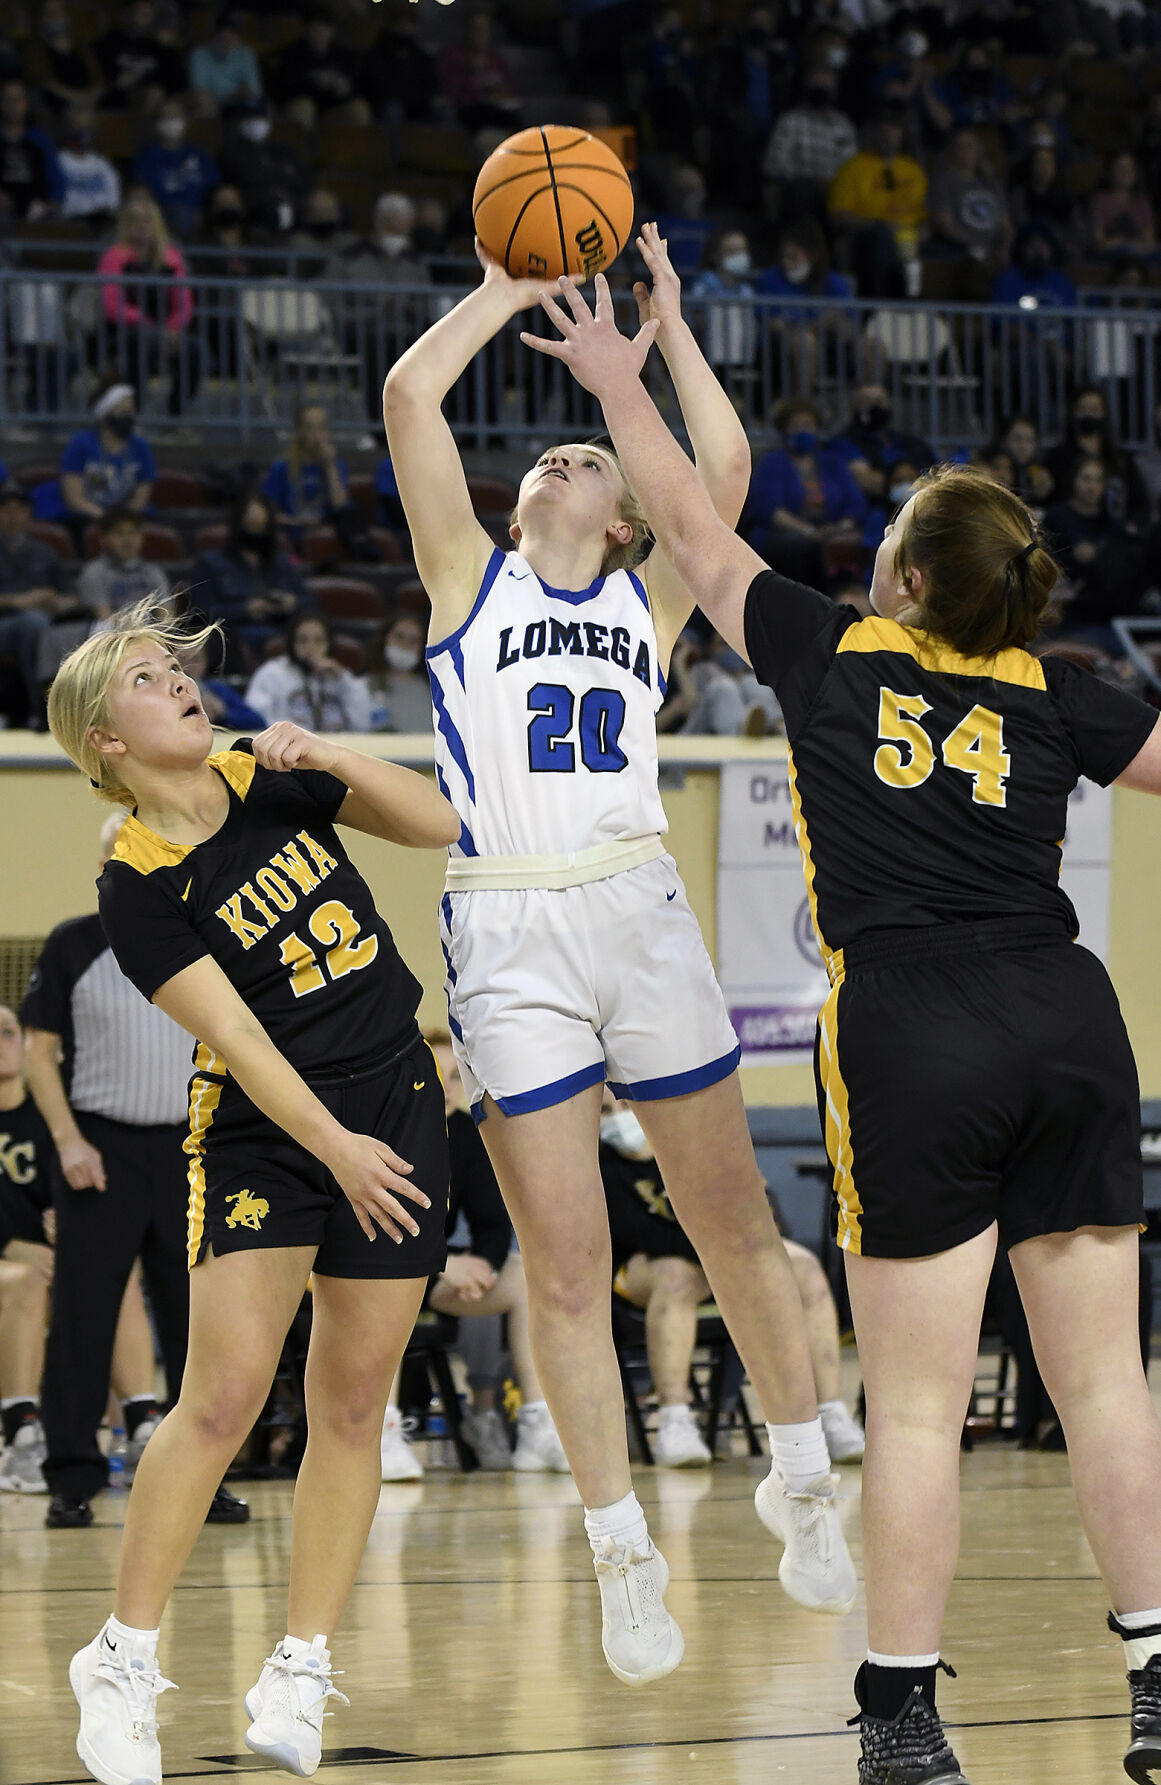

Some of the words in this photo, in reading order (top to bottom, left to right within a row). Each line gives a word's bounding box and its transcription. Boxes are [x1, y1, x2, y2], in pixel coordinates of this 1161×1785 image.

[575, 219, 607, 277] Wil
[496, 617, 651, 691] LOMEGA
[527, 682, 629, 773] 20
[874, 686, 1011, 808] 54
[764, 821, 799, 848] M
[215, 829, 339, 950] KIOWA
[278, 899, 379, 998] 12
